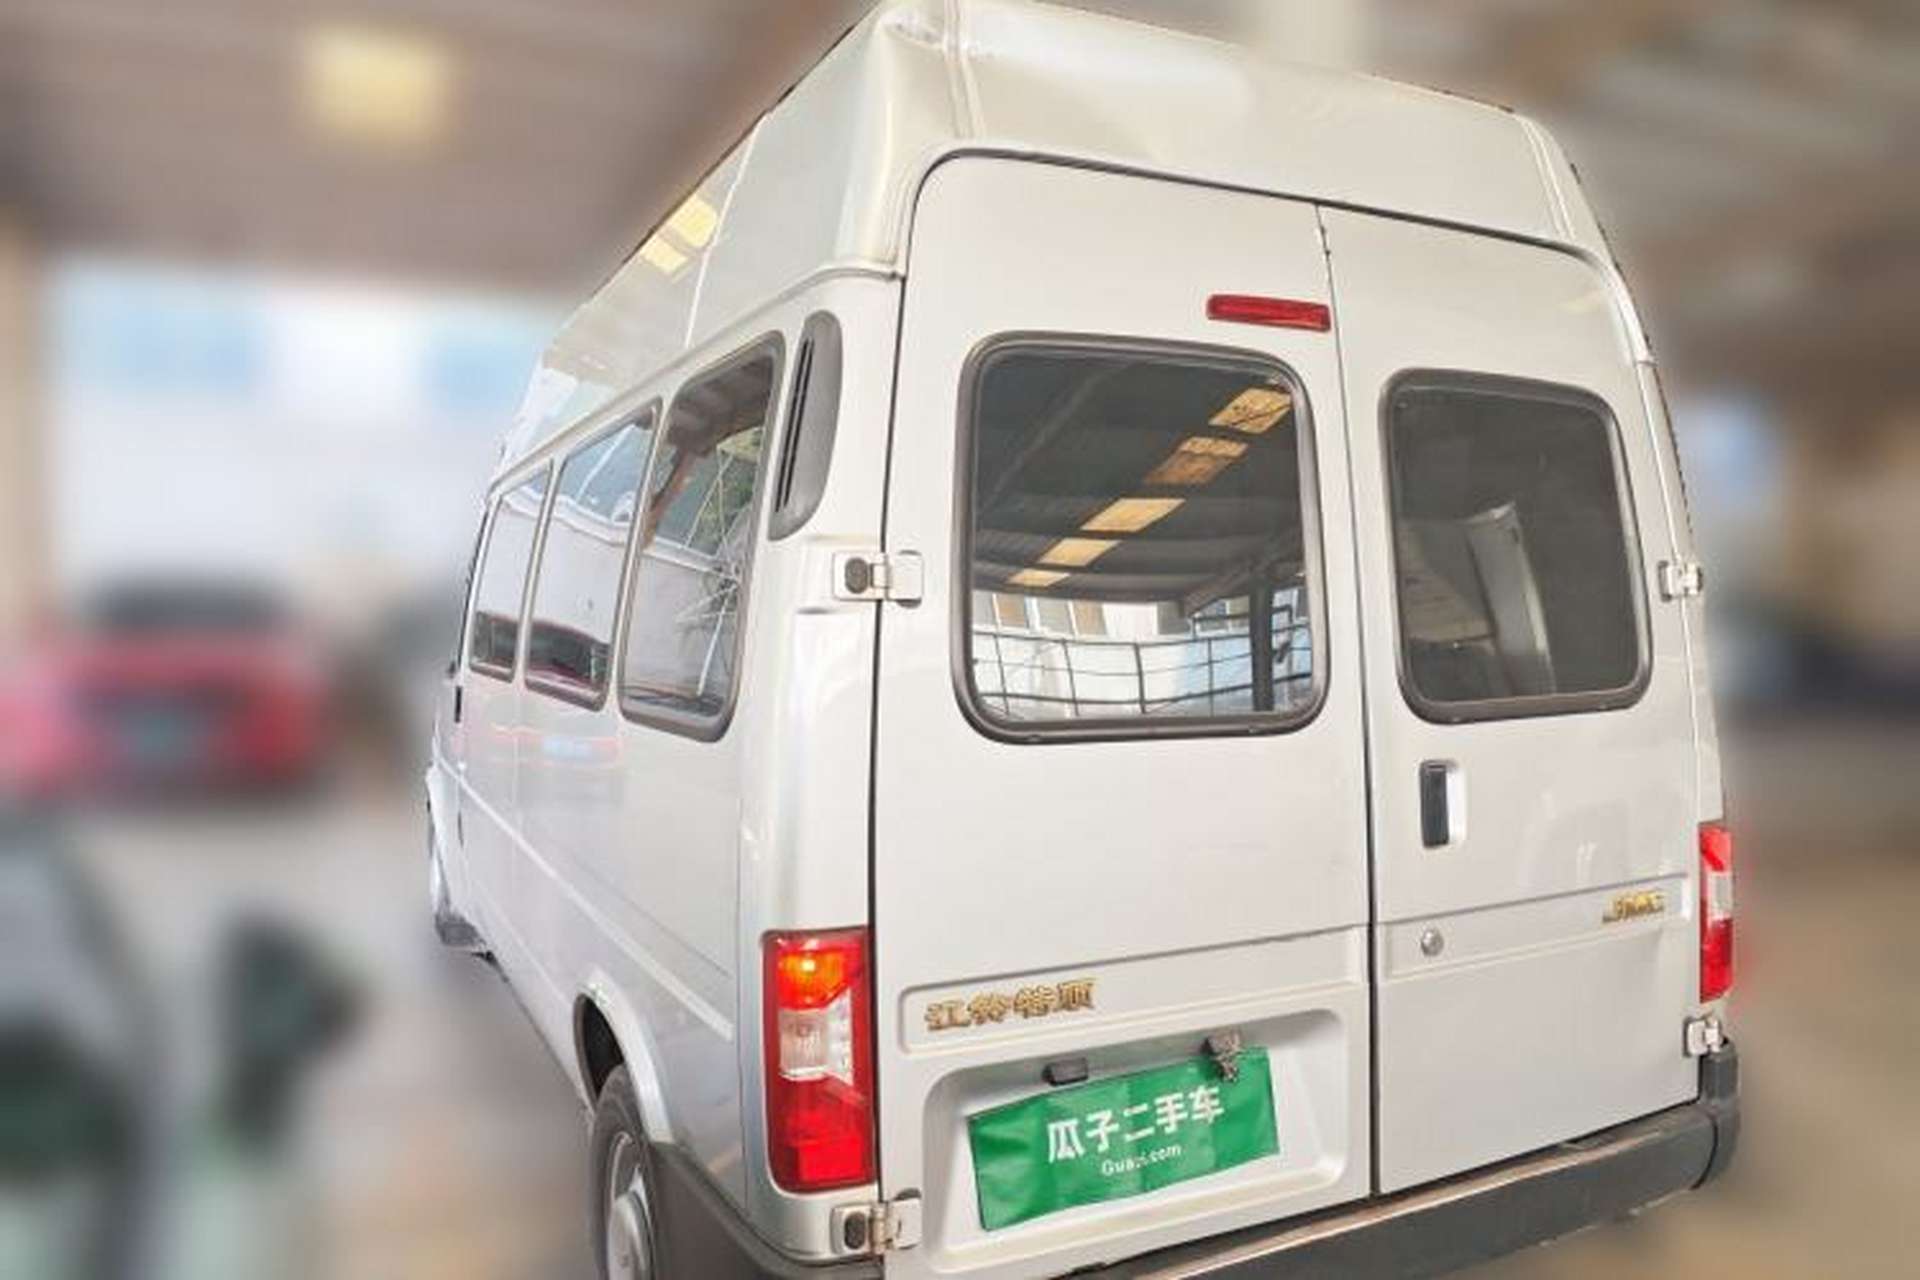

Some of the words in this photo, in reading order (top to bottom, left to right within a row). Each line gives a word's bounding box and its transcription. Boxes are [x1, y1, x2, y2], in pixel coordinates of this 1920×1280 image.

[1047, 1085, 1225, 1163] 瓜子二手车
